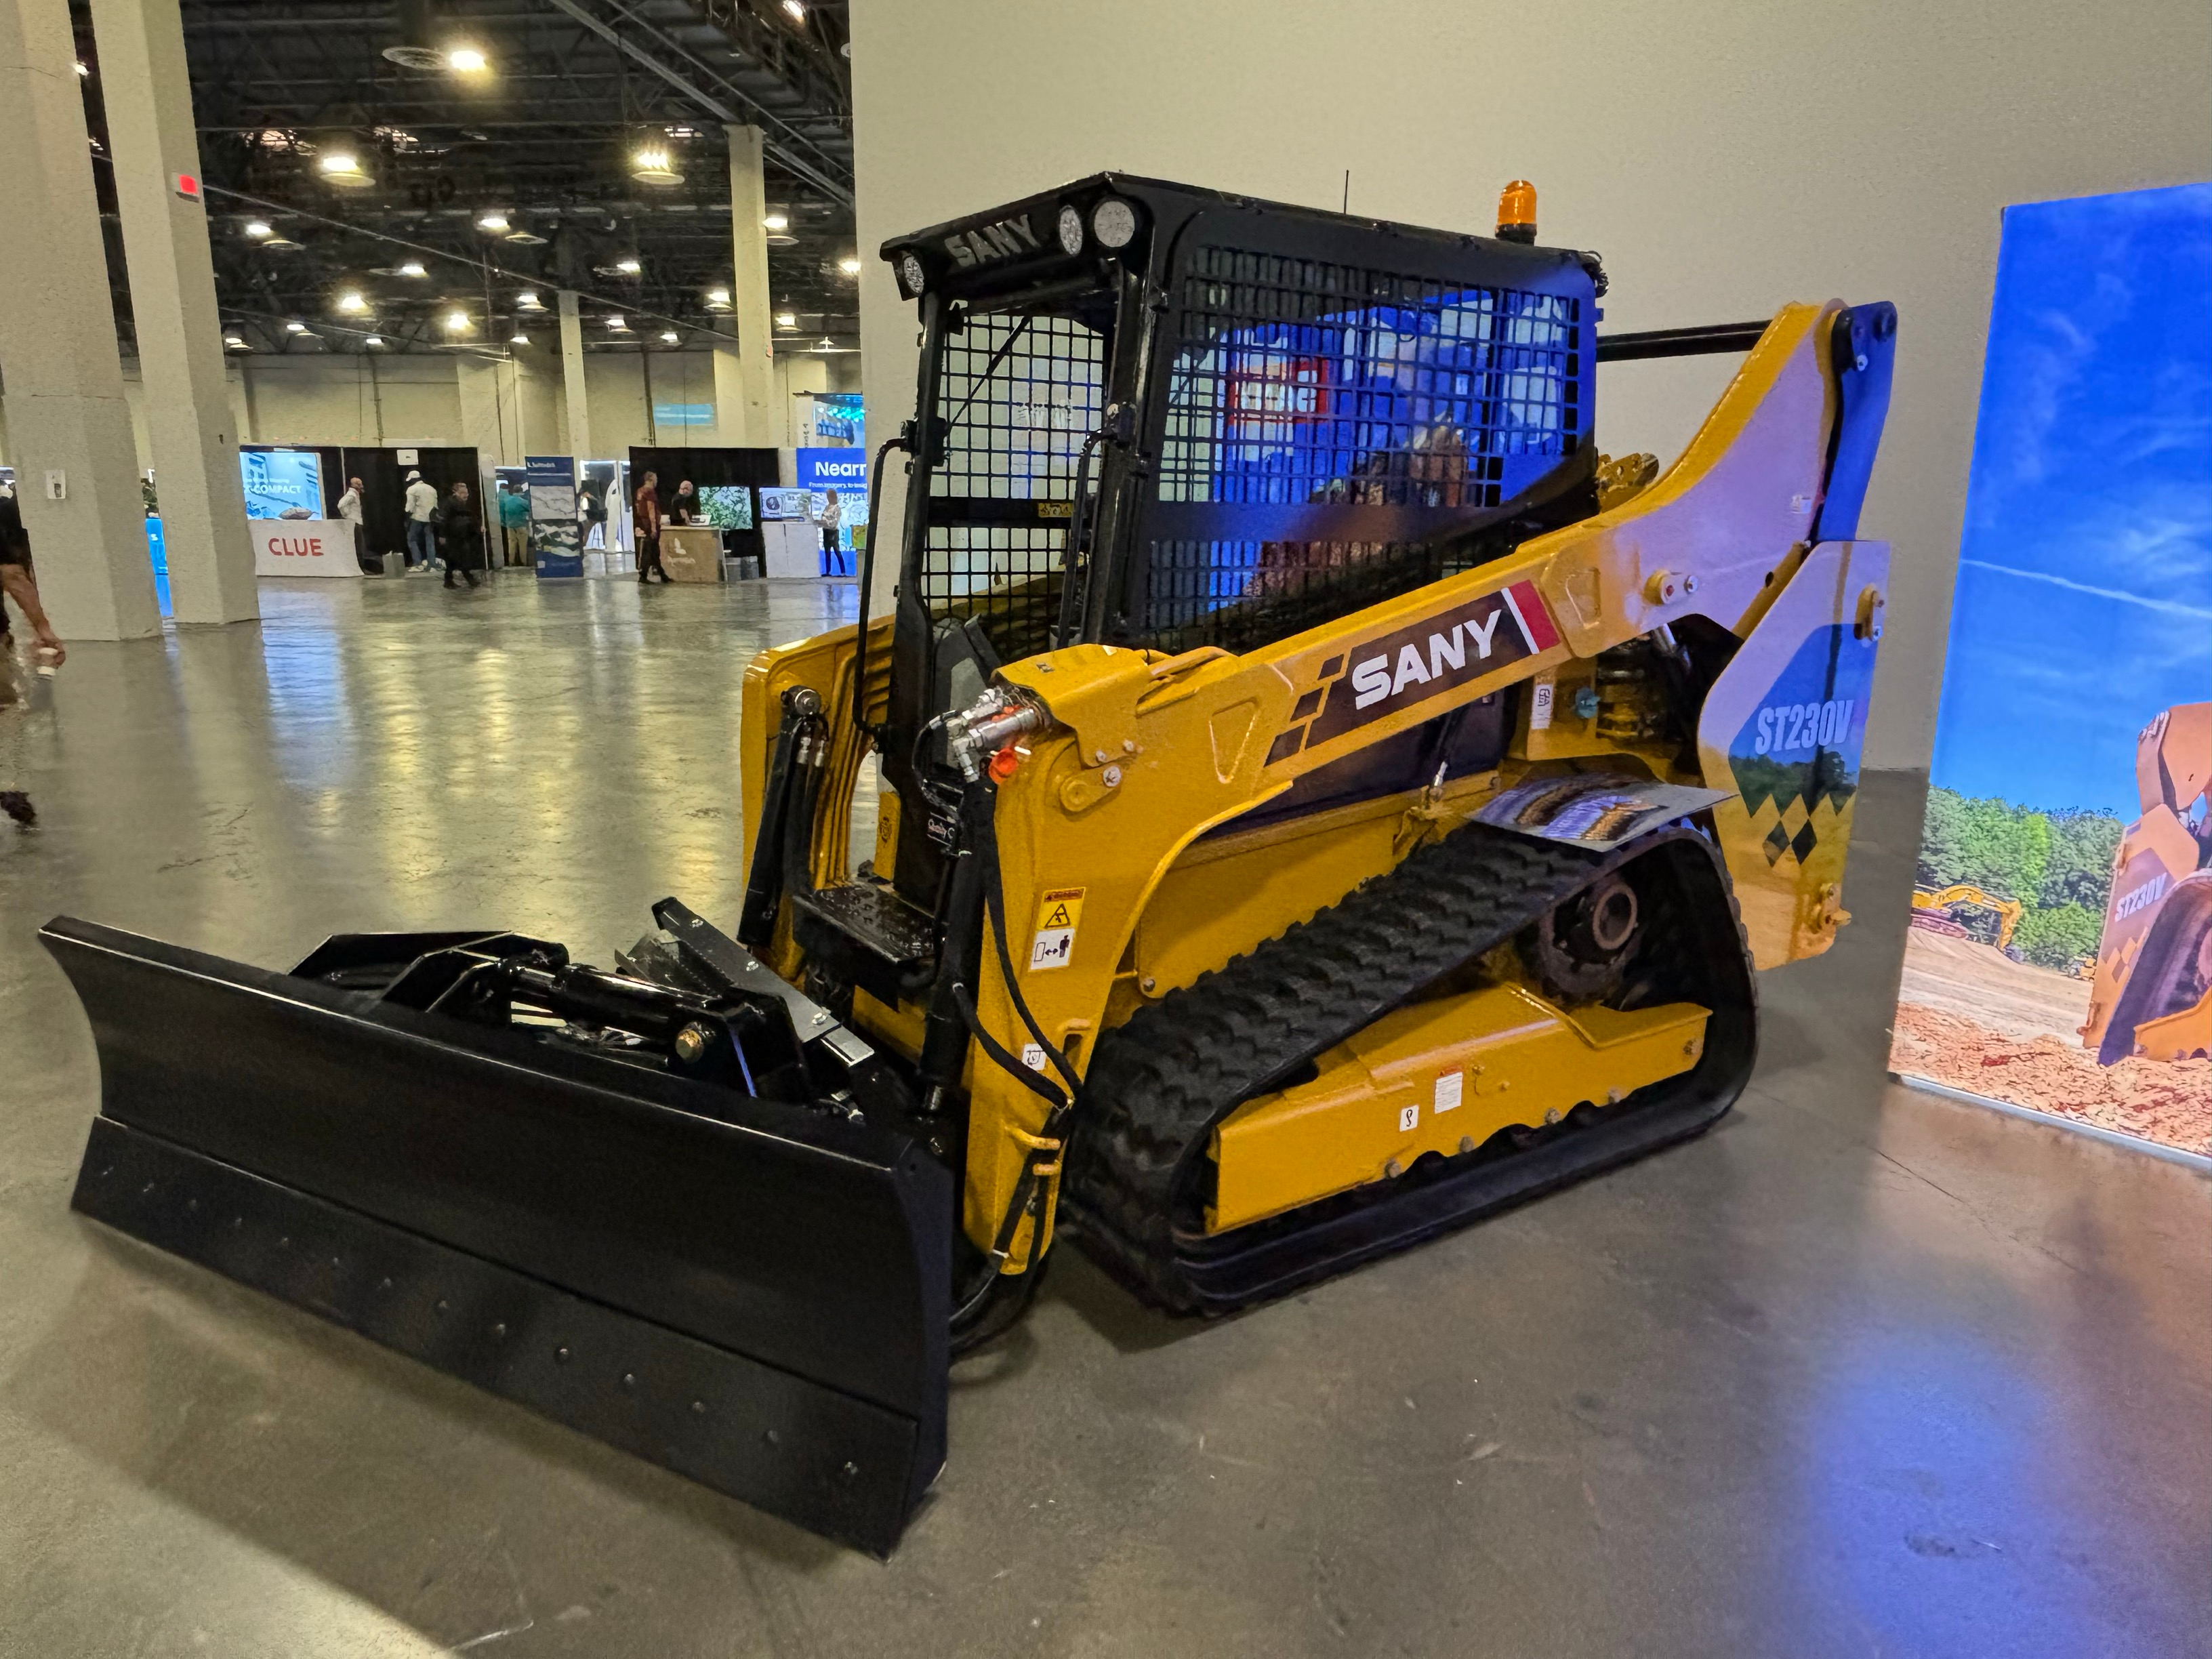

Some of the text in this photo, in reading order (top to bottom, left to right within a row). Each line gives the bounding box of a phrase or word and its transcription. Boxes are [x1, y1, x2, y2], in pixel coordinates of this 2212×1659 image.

[944, 213, 1041, 268] SANY
[268, 537, 324, 556] CLUE
[1351, 609, 1502, 710] SANY
[1754, 699, 1855, 755] ST230V
[2114, 872, 2167, 922] ST230V
